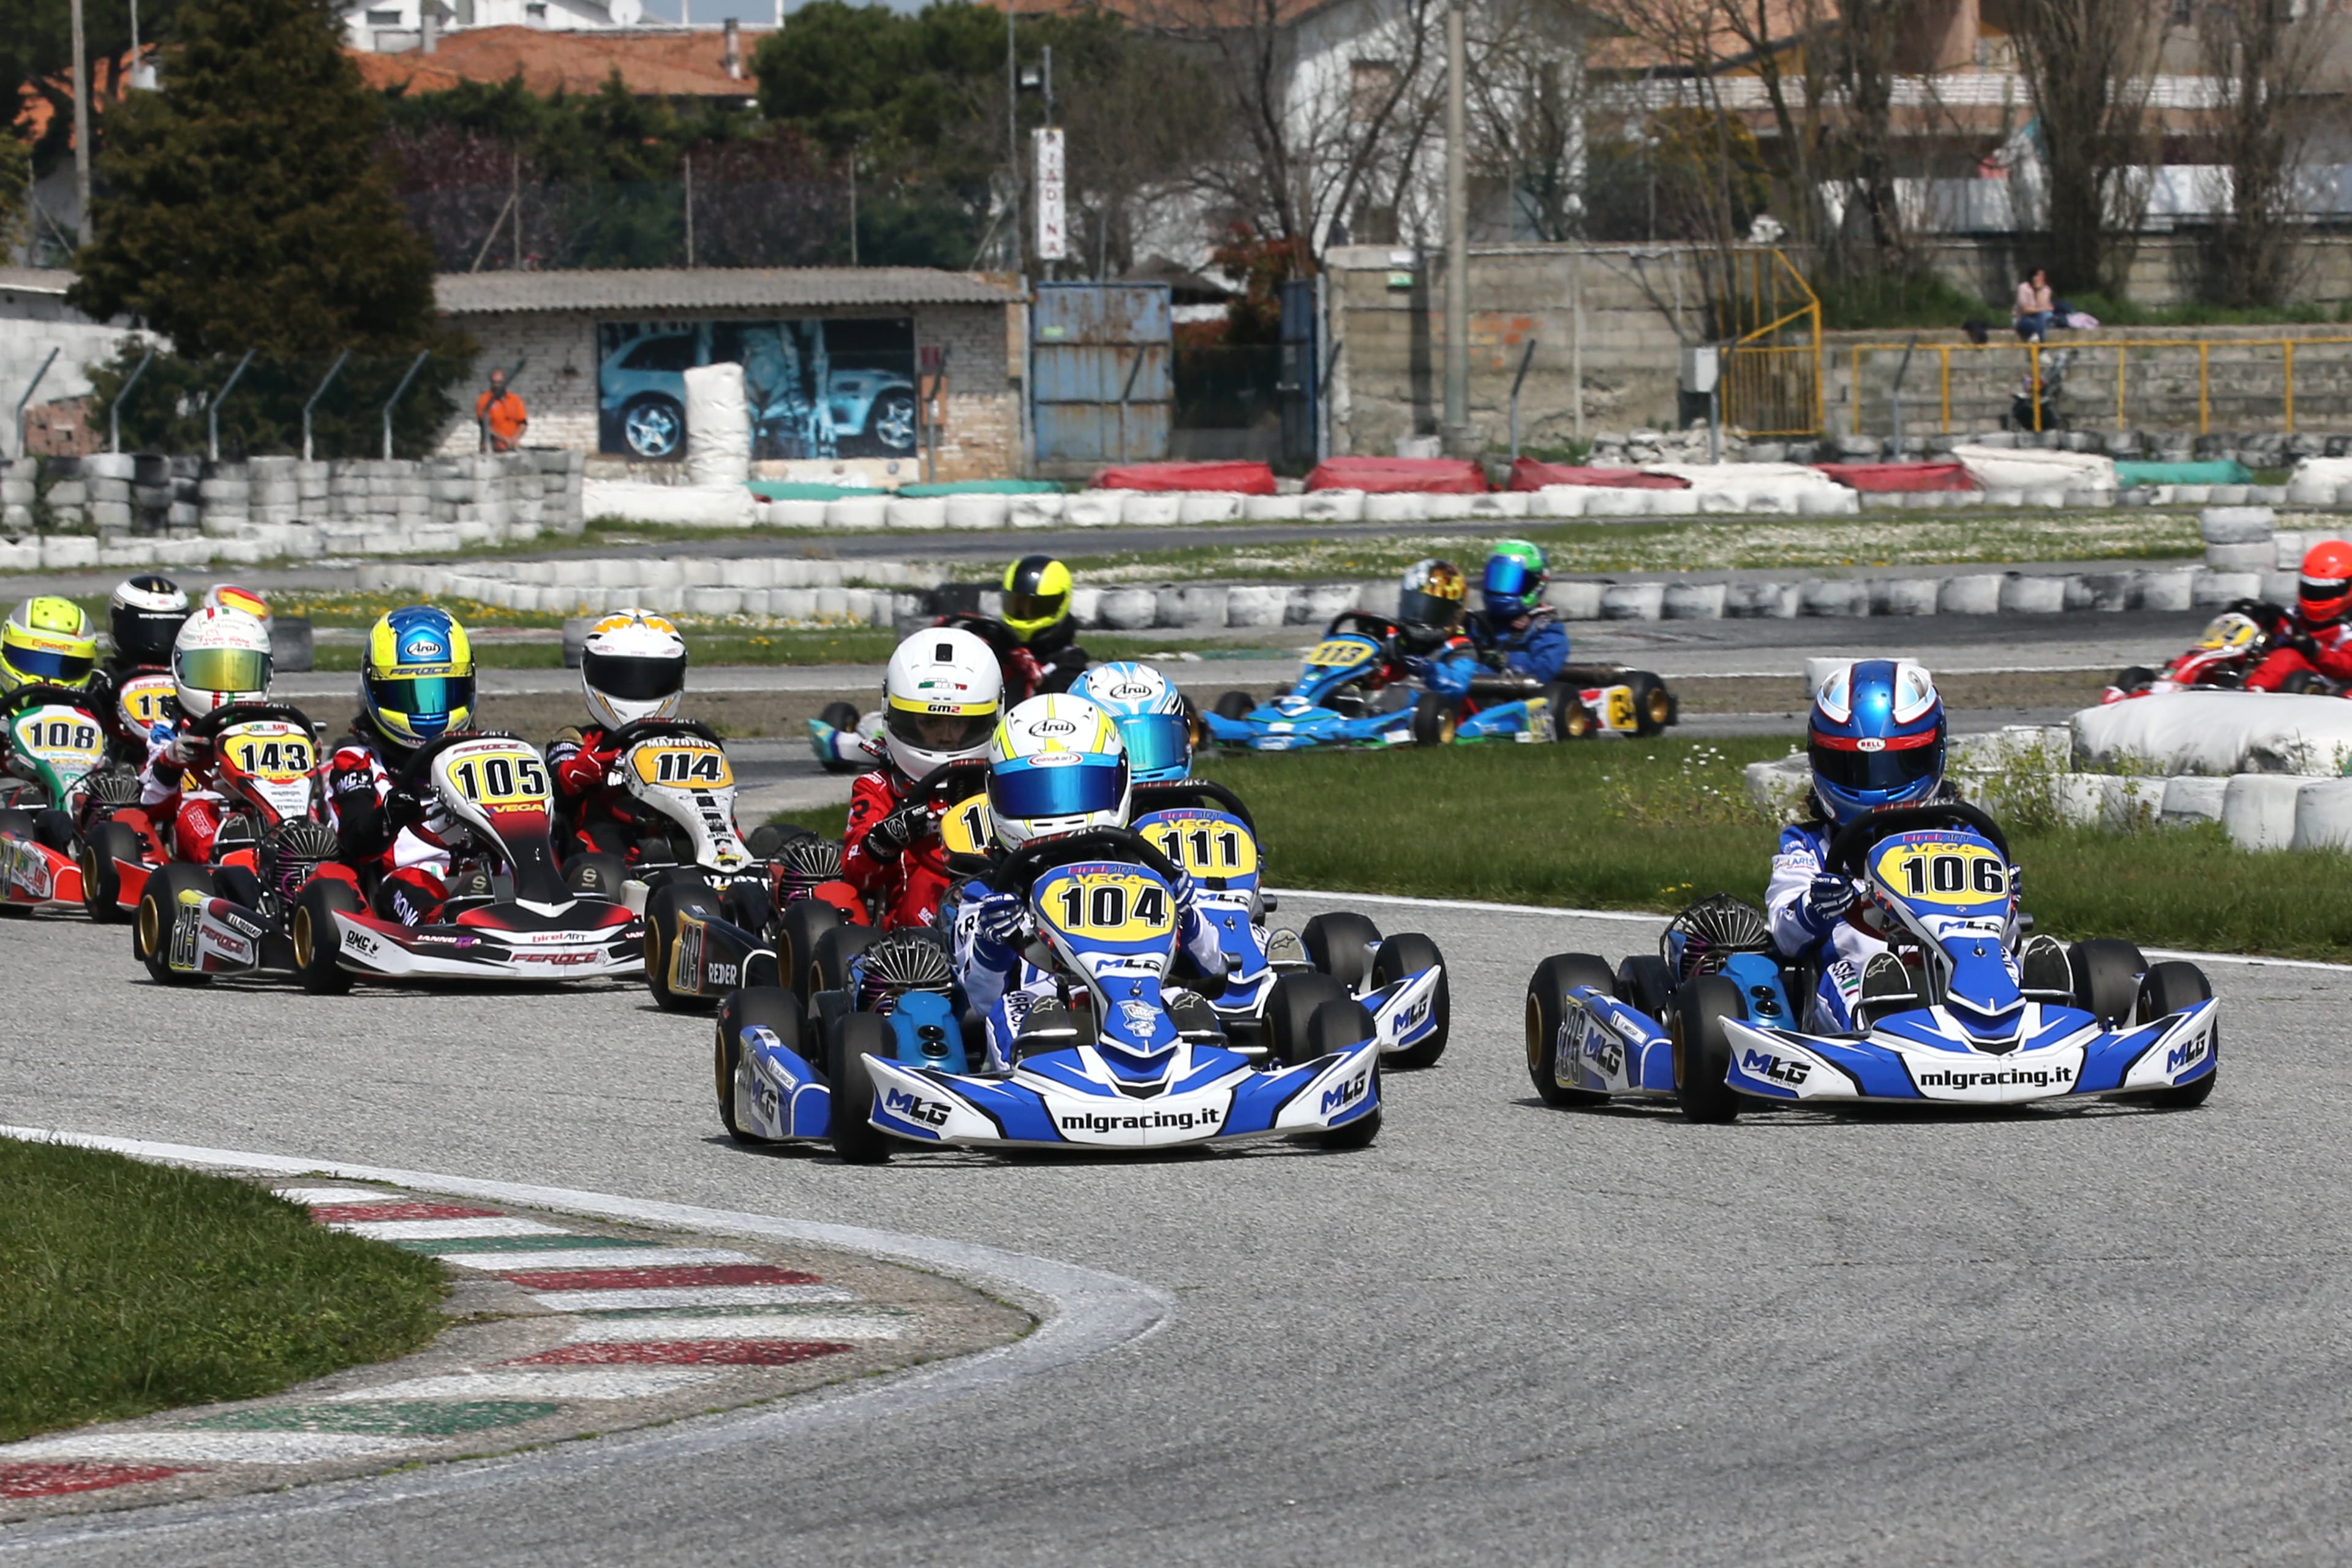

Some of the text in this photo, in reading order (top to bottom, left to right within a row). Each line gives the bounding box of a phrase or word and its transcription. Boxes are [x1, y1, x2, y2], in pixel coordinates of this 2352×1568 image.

[1314, 645, 1364, 662] 113
[390, 666, 451, 676] FEROCE
[927, 704, 961, 714] GM2
[28, 721, 96, 749] 108
[238, 741, 311, 774] 143
[453, 743, 519, 755] FEROCE
[455, 756, 548, 804] 105
[652, 752, 725, 783] 114
[492, 804, 545, 813] VEGA
[1167, 818, 1229, 829] VEGA
[1158, 829, 1240, 868] 111
[1910, 842, 1977, 854] VEGA
[1075, 873, 1144, 885] VEGA
[1900, 854, 2008, 897] 106
[1058, 884, 1169, 929] 104
[170, 903, 202, 967] 105
[200, 924, 245, 954] FEROCE
[345, 930, 371, 951] OMC
[532, 933, 588, 943] birelART
[1939, 921, 2002, 935] MLG
[510, 951, 598, 965] FEROCE
[1095, 959, 1162, 974] MLG
[1392, 993, 1429, 1036] MLG
[1583, 1026, 1623, 1076] MLG
[2166, 1029, 2207, 1074] MLG
[1742, 1048, 1812, 1085] MLG
[1920, 1066, 2073, 1090] mlgracing.it
[1321, 1068, 1367, 1115] MLG
[1768, 1077, 1798, 1089] RACING
[885, 1087, 952, 1126] MLG
[911, 1117, 939, 1130] RACING
[1061, 1107, 1220, 1133] mlgracing.it
